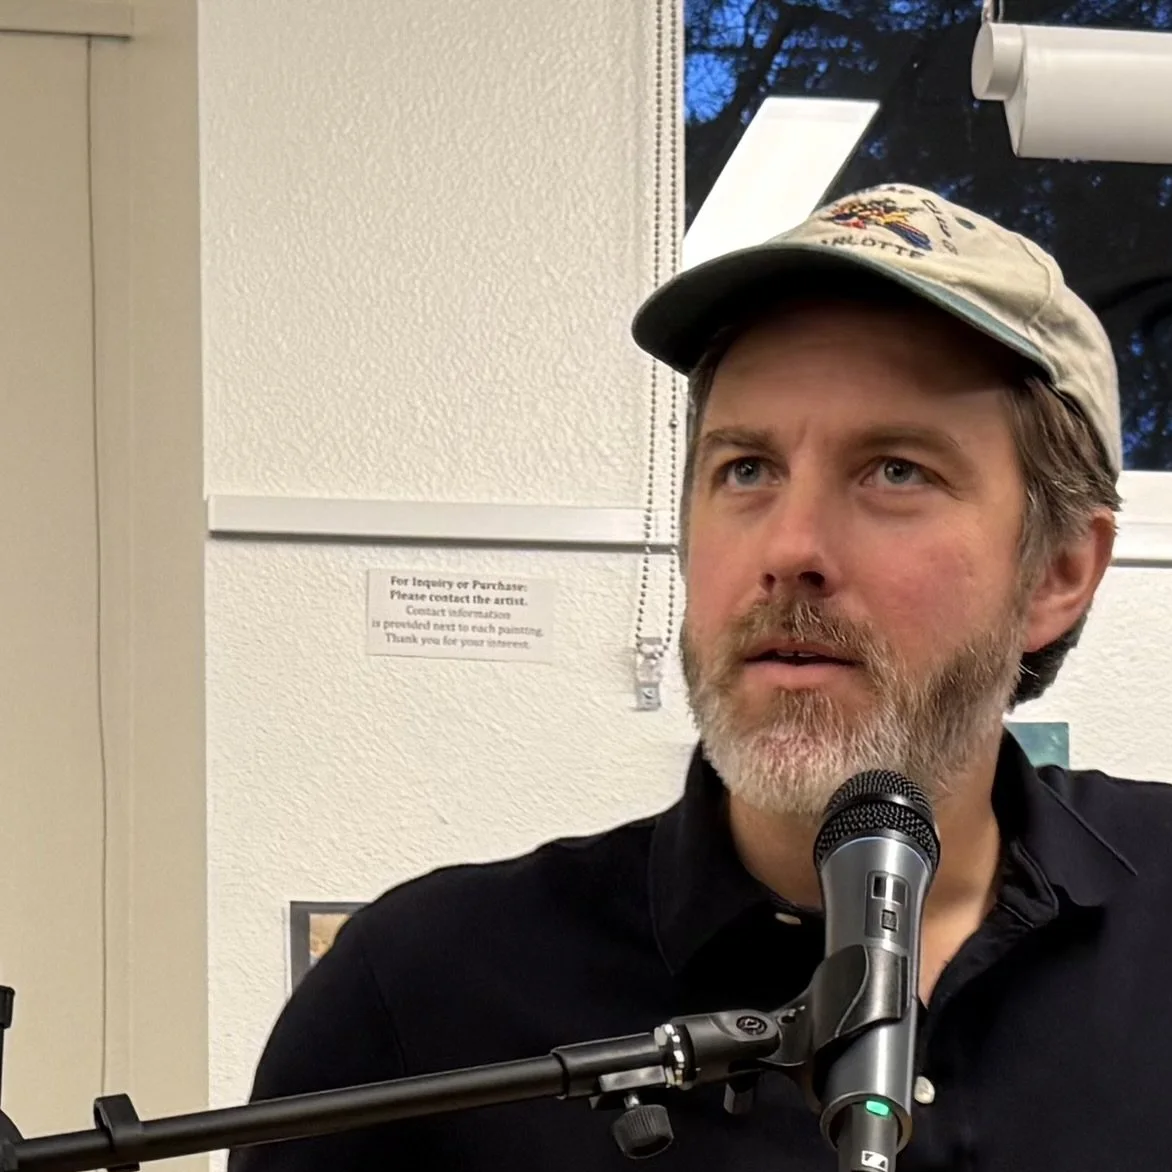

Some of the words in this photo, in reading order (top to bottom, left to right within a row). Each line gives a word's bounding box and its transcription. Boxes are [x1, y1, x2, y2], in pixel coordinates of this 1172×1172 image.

[390, 575, 409, 587] For
[412, 577, 454, 590] Inquiry
[456, 581, 470, 590] or
[472, 580, 528, 592] Purchase:
[389, 590, 427, 602] Please
[428, 593, 470, 604] contact
[472, 594, 491, 605] the
[493, 595, 528, 606] artist.
[406, 605, 446, 617] Contact
[449, 608, 512, 620] information
[371, 619, 381, 628] is
[383, 619, 431, 632] provided
[433, 622, 456, 632] next
[458, 623, 470, 632] to
[471, 622, 496, 633] each
[385, 632, 418, 644] Thank
[420, 635, 441, 647] you
[443, 635, 458, 646] for
[460, 638, 485, 649] your
